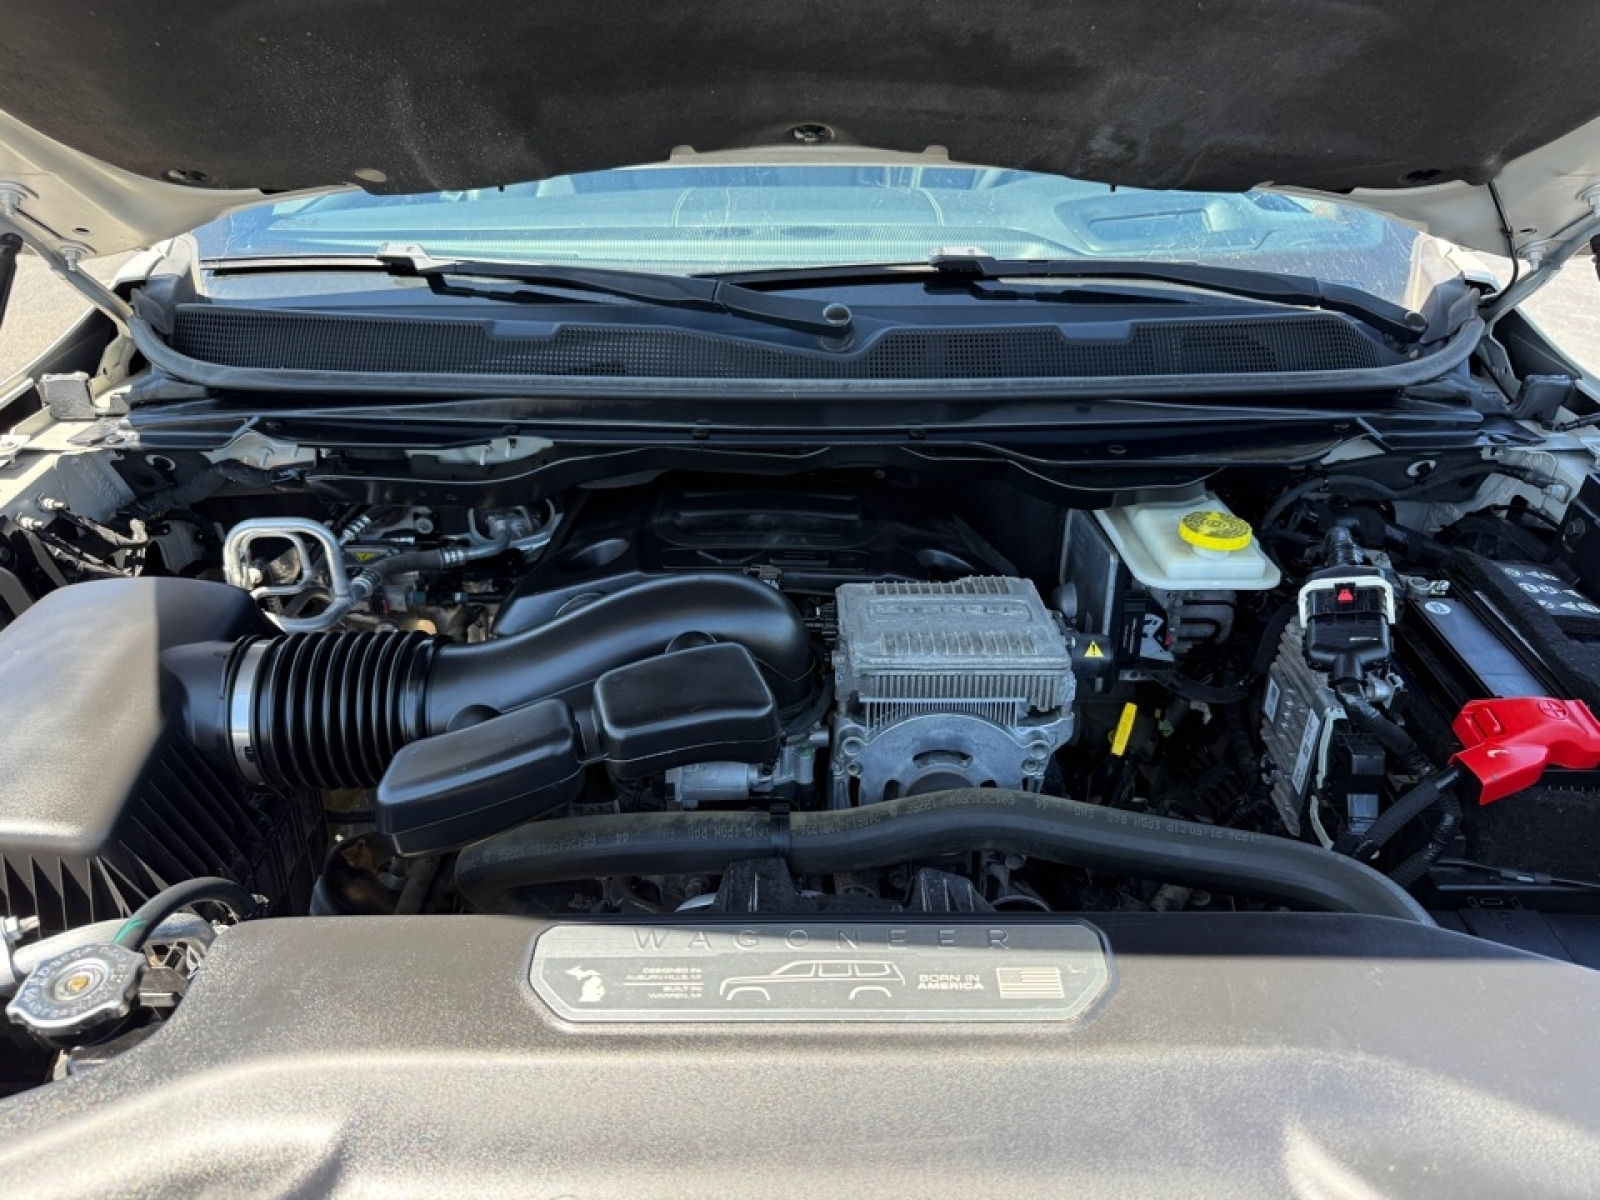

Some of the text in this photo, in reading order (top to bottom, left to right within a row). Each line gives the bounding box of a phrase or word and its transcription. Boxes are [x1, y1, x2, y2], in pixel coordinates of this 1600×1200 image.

[633, 929, 1010, 951] WAGONEER
[919, 974, 980, 983] BORN IN
[917, 982, 985, 991] AMERICA
